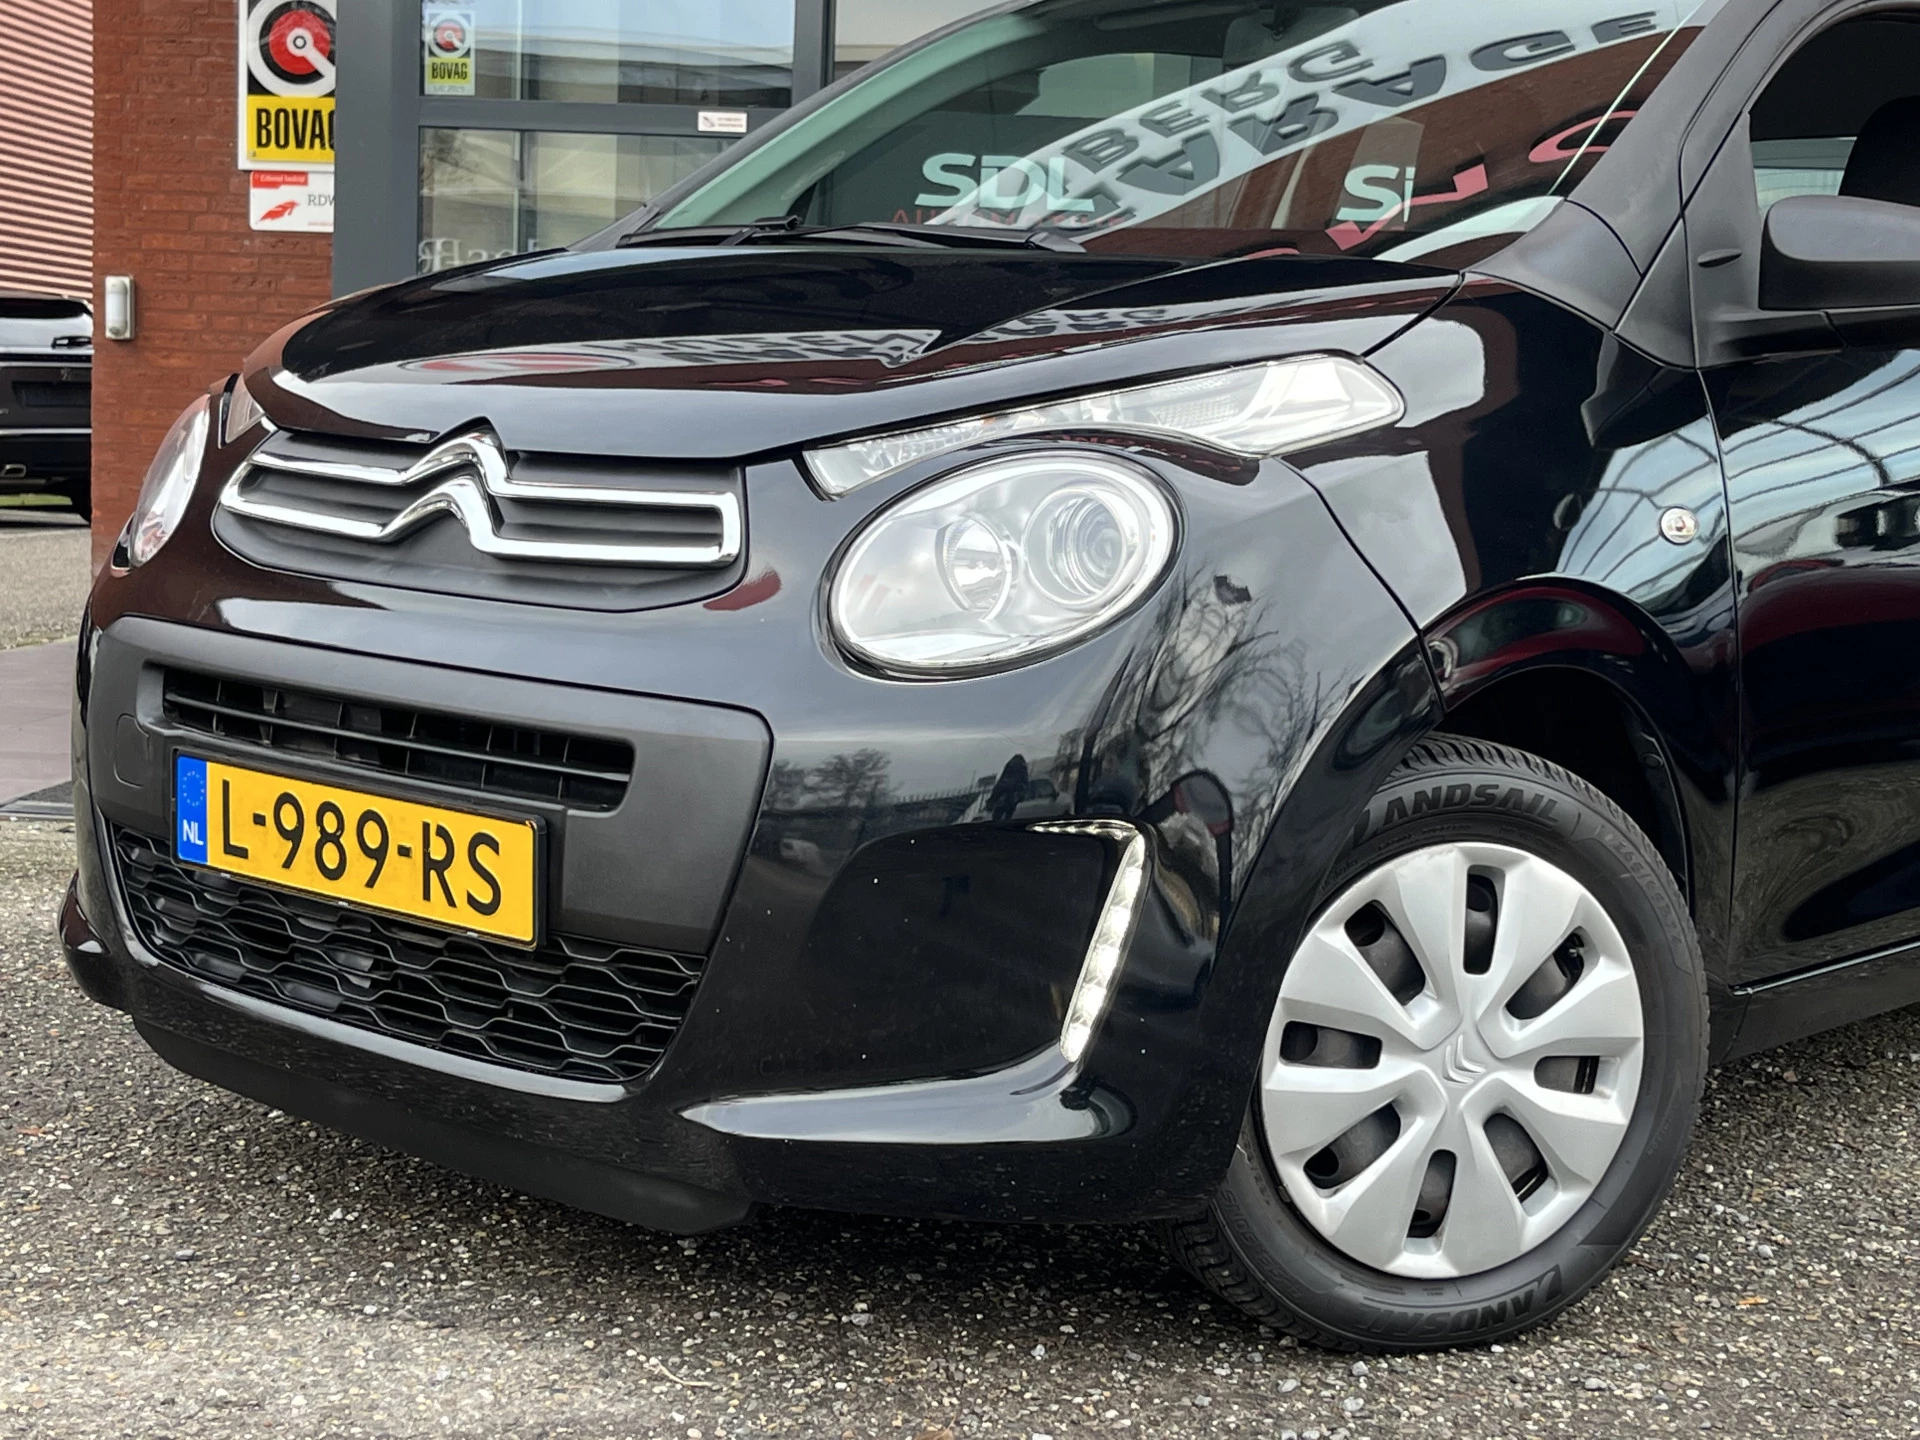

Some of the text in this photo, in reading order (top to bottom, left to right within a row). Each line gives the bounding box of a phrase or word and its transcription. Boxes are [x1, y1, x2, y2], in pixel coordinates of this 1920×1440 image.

[432, 62, 468, 80] BOVAG
[914, 153, 1095, 212] SDL
[182, 819, 204, 846] NL
[222, 779, 502, 916] L-989-RS
